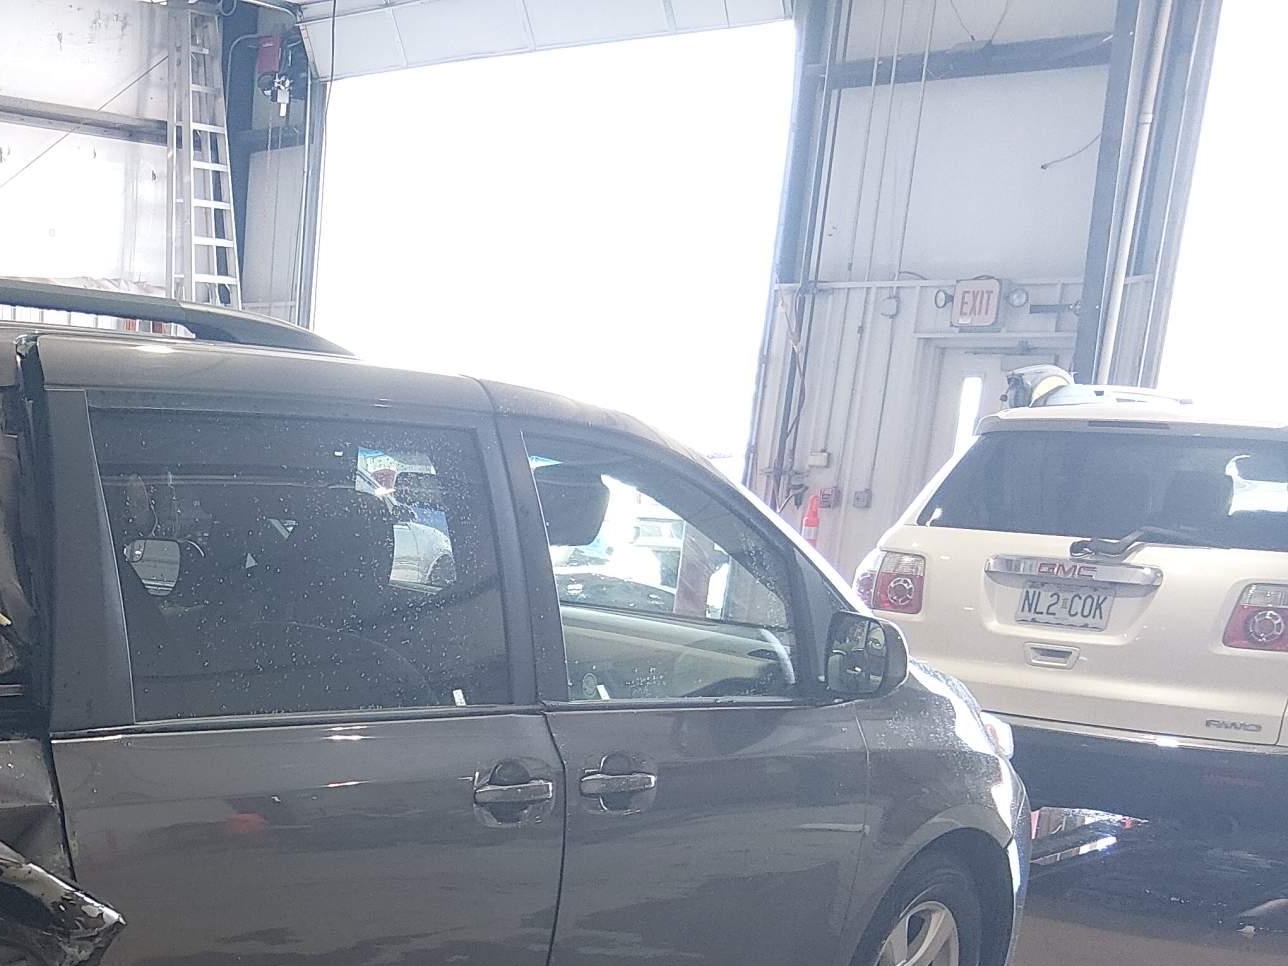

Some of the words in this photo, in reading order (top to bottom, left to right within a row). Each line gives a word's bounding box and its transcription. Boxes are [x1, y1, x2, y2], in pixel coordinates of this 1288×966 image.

[960, 290, 994, 316] EXIT
[1038, 563, 1097, 578] GMC
[1021, 590, 1060, 616] NL2
